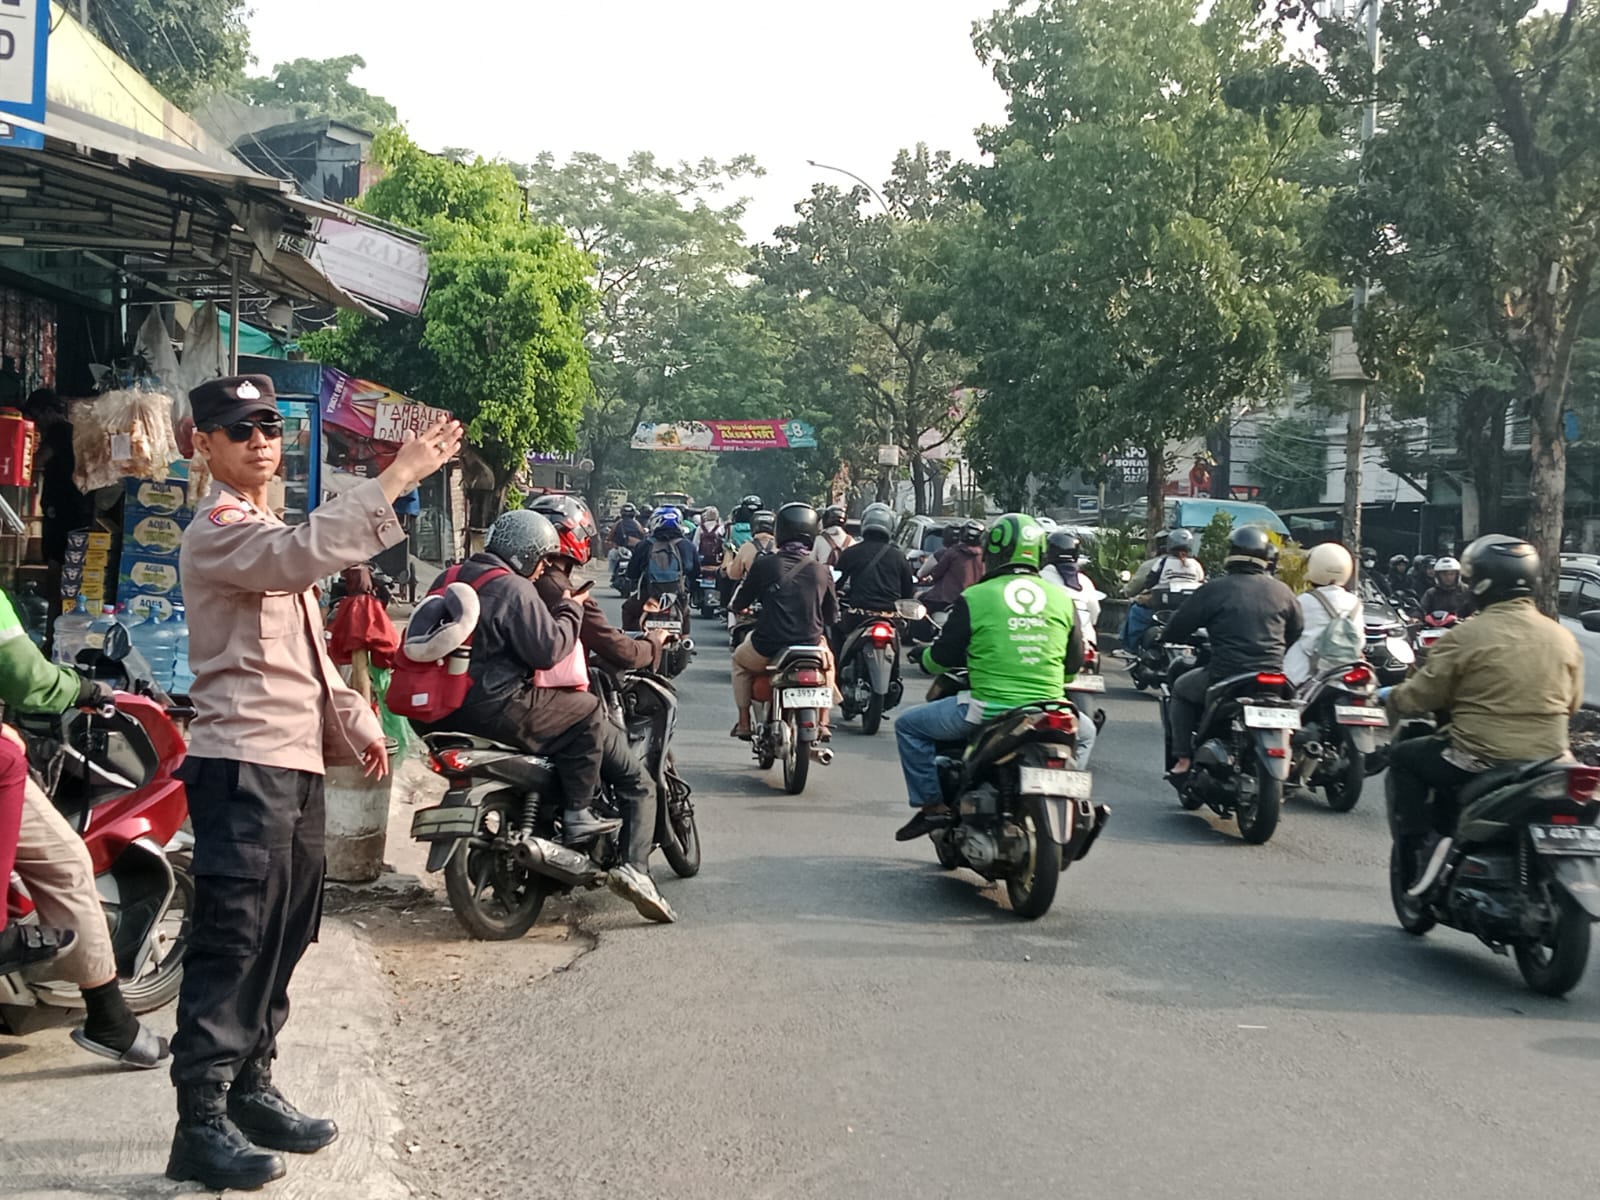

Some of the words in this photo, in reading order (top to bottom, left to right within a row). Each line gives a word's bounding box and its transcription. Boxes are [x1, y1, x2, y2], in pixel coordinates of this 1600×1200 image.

[752, 430, 776, 439] MRT
[147, 520, 171, 531] AQUA
[144, 564, 165, 573] AQUA
